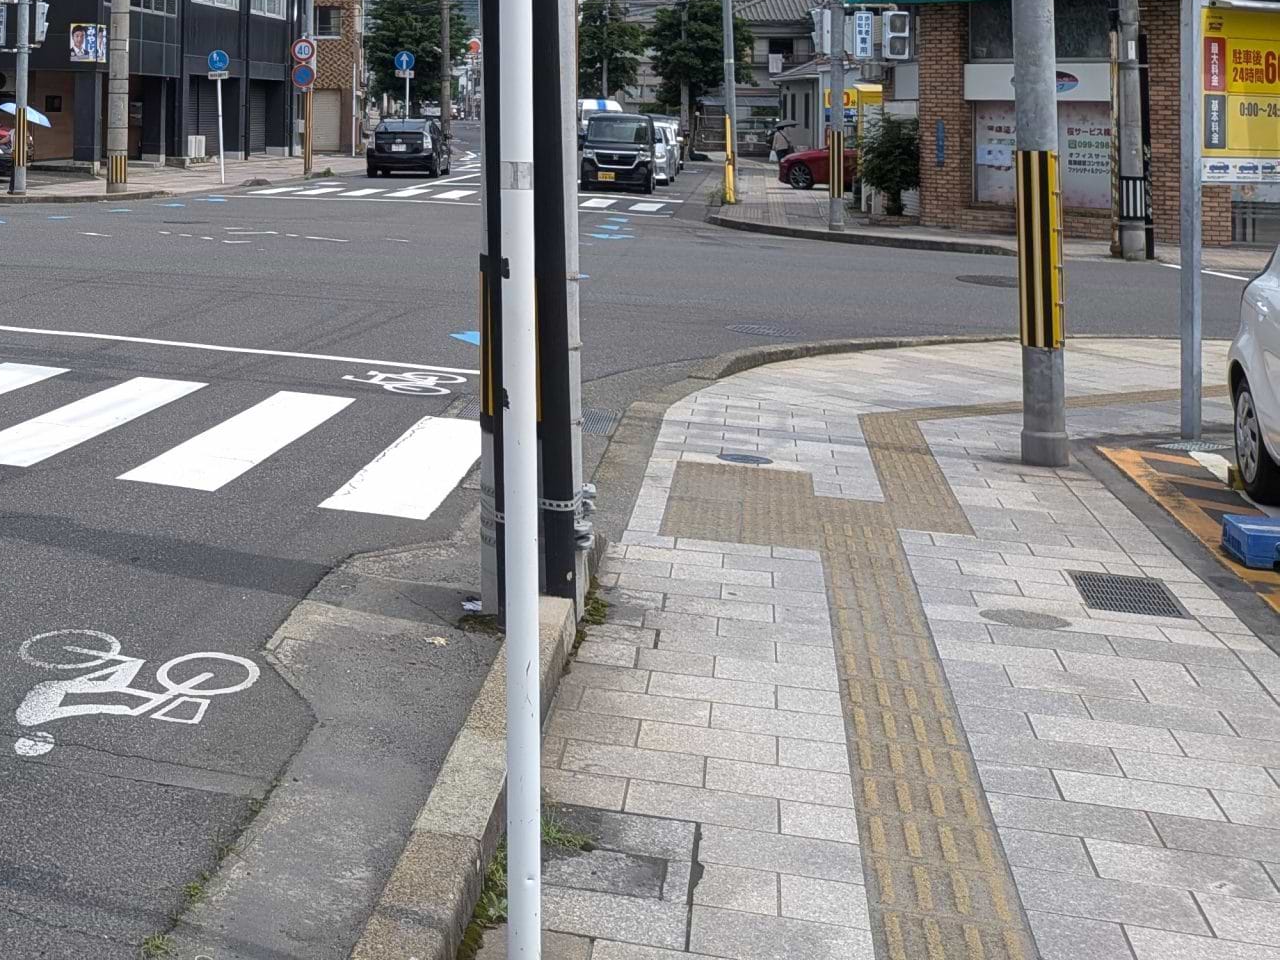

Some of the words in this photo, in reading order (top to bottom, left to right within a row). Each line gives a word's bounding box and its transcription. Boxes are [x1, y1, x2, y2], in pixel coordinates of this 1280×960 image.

[297, 45, 310, 56] 40
[1232, 48, 1262, 66] 駐車後
[1211, 42, 1219, 86] 最大料金
[1232, 66, 1264, 84] 24時間
[1265, 50, 1280, 85] 6
[1211, 99, 1219, 144] 基本料金
